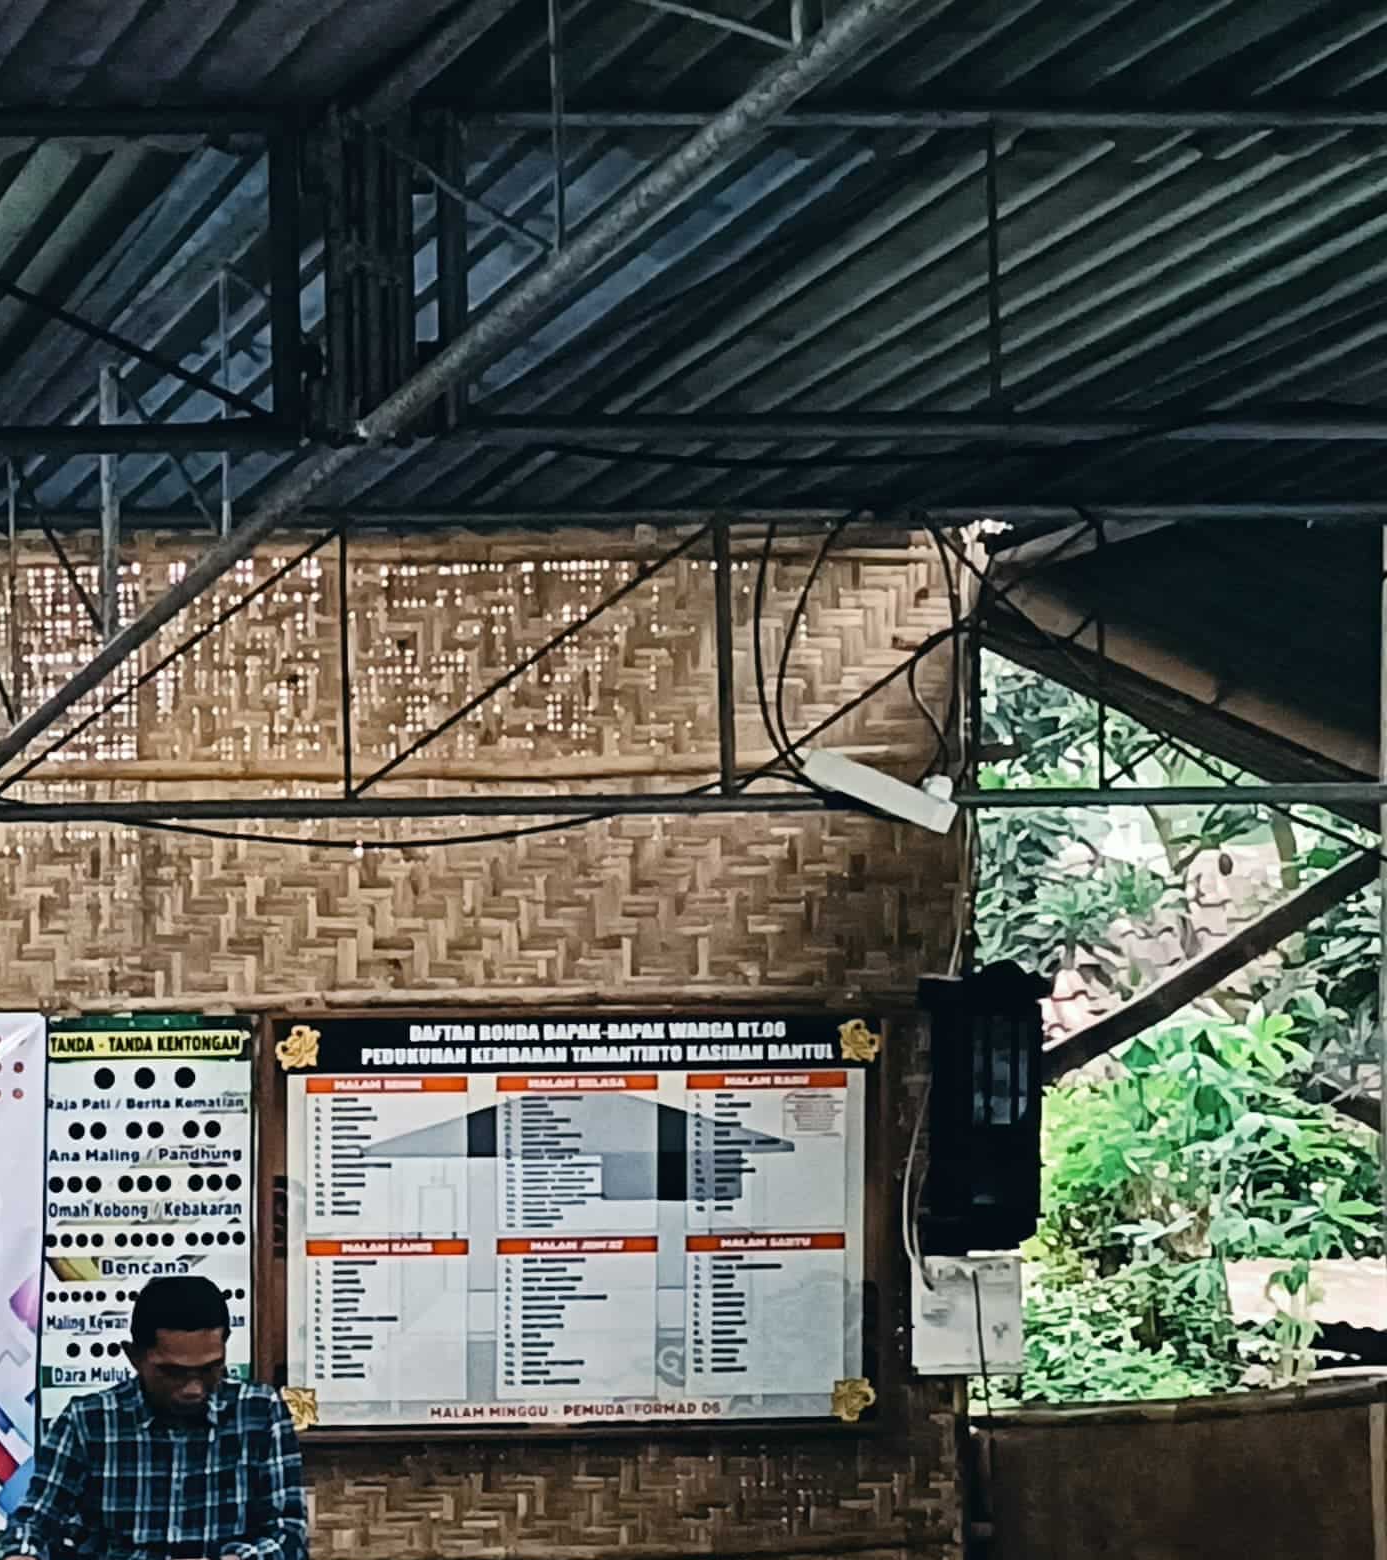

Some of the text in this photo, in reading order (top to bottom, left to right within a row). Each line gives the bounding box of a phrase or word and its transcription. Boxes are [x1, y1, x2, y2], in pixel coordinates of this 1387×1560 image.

[668, 1023, 734, 1039] WARGA
[50, 1037, 95, 1053] TANDA
[108, 1036, 153, 1052] TANDA
[157, 1034, 241, 1051] KENTONGAN
[47, 1098, 77, 1112] Raja
[82, 1098, 111, 1111] Pati
[126, 1097, 171, 1110] Berita
[175, 1096, 245, 1110] Kematian
[48, 1149, 81, 1163] Ana
[85, 1149, 140, 1165] Maling
[158, 1147, 243, 1163] Pandhung
[47, 1202, 90, 1218] Omah
[94, 1202, 149, 1219] Kobong
[164, 1201, 243, 1218] Kebakaran
[101, 1259, 190, 1276] Bencana
[46, 1315, 86, 1332] Maling
[54, 1369, 87, 1383] Dara
[430, 1406, 485, 1418] MALAM
[489, 1405, 549, 1417] MINGGU
[563, 1404, 626, 1417] PEMUDA
[634, 1403, 698, 1416] FORMAD
